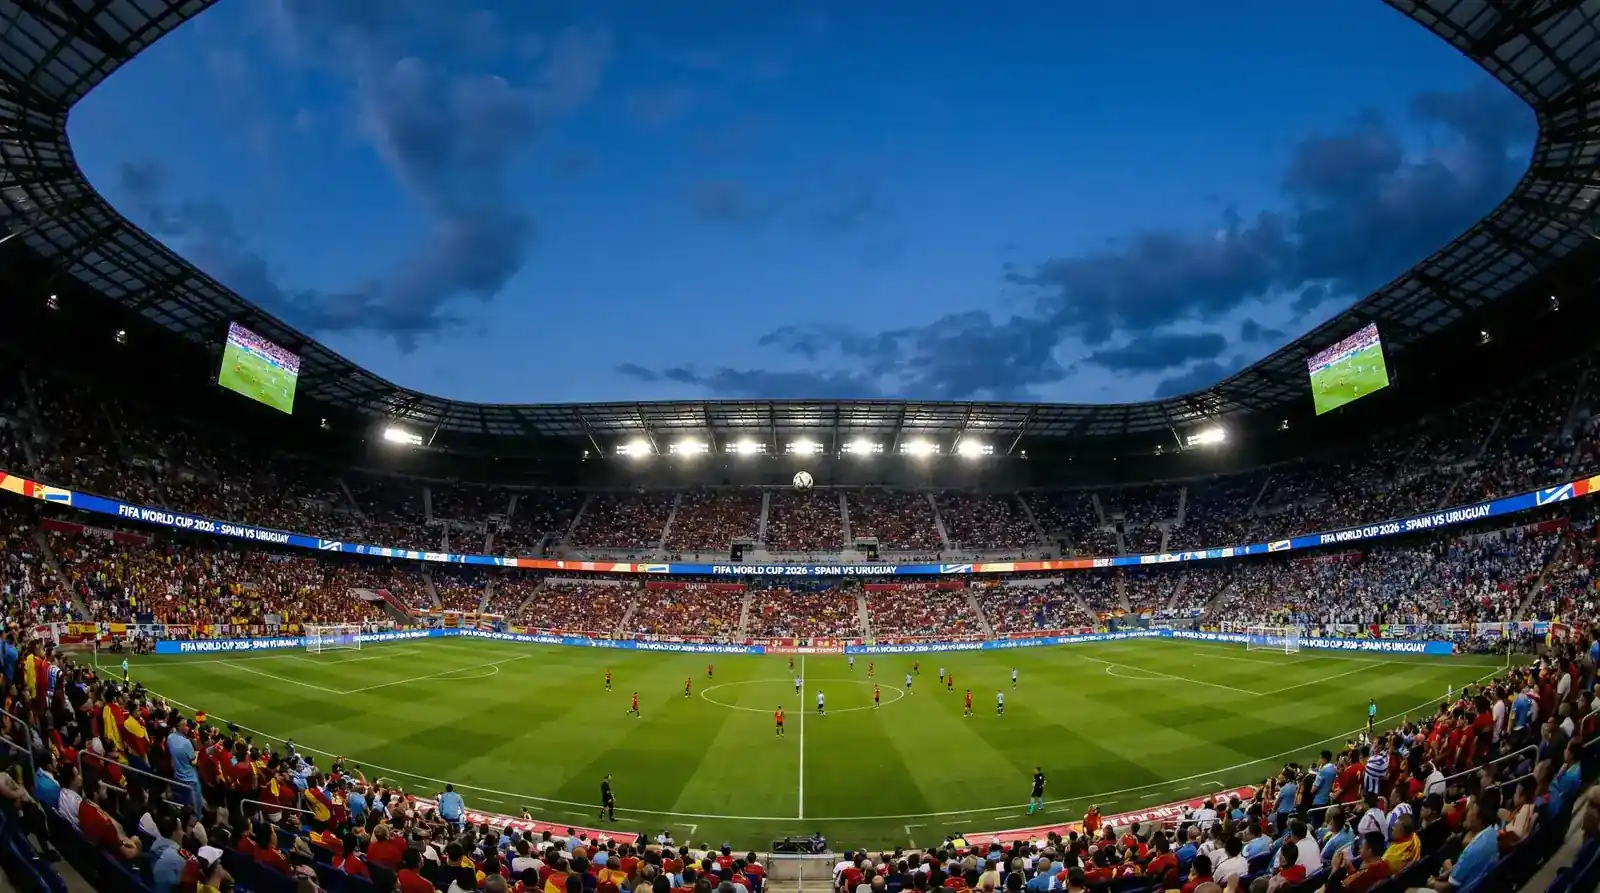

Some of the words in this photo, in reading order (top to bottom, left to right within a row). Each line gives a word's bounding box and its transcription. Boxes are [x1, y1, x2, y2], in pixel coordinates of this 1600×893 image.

[119, 505, 139, 519] FIFA
[141, 509, 174, 525] WORLD
[175, 516, 193, 529] CUP
[194, 520, 214, 532] 2026
[220, 524, 244, 537] SPAIN
[245, 528, 256, 539] VS
[256, 530, 290, 544] URUGUAY
[1320, 534, 1336, 545] FIFA
[1336, 530, 1362, 542] WORLD
[1363, 526, 1378, 538] CUP
[1379, 522, 1400, 536] 2026
[1406, 516, 1432, 531] SPAIN
[1432, 514, 1444, 526] VS
[1446, 505, 1491, 523] URUGUAY
[712, 566, 732, 574] FIFA
[732, 566, 764, 575] WORLD
[766, 566, 784, 575] CUP
[785, 566, 808, 575] 2026
[814, 566, 841, 575] SPAIN
[842, 566, 854, 575] VS
[856, 566, 897, 575] URUGUAY
[180, 642, 196, 651] FIFA
[196, 641, 220, 651] WORLD
[222, 641, 234, 650] CUP
[1310, 640, 1329, 648] WORLD
[1330, 640, 1342, 648] CUP
[1362, 642, 1381, 650] SPAIN
[1382, 642, 1392, 651] VS
[1392, 642, 1426, 652] URUGUAY
